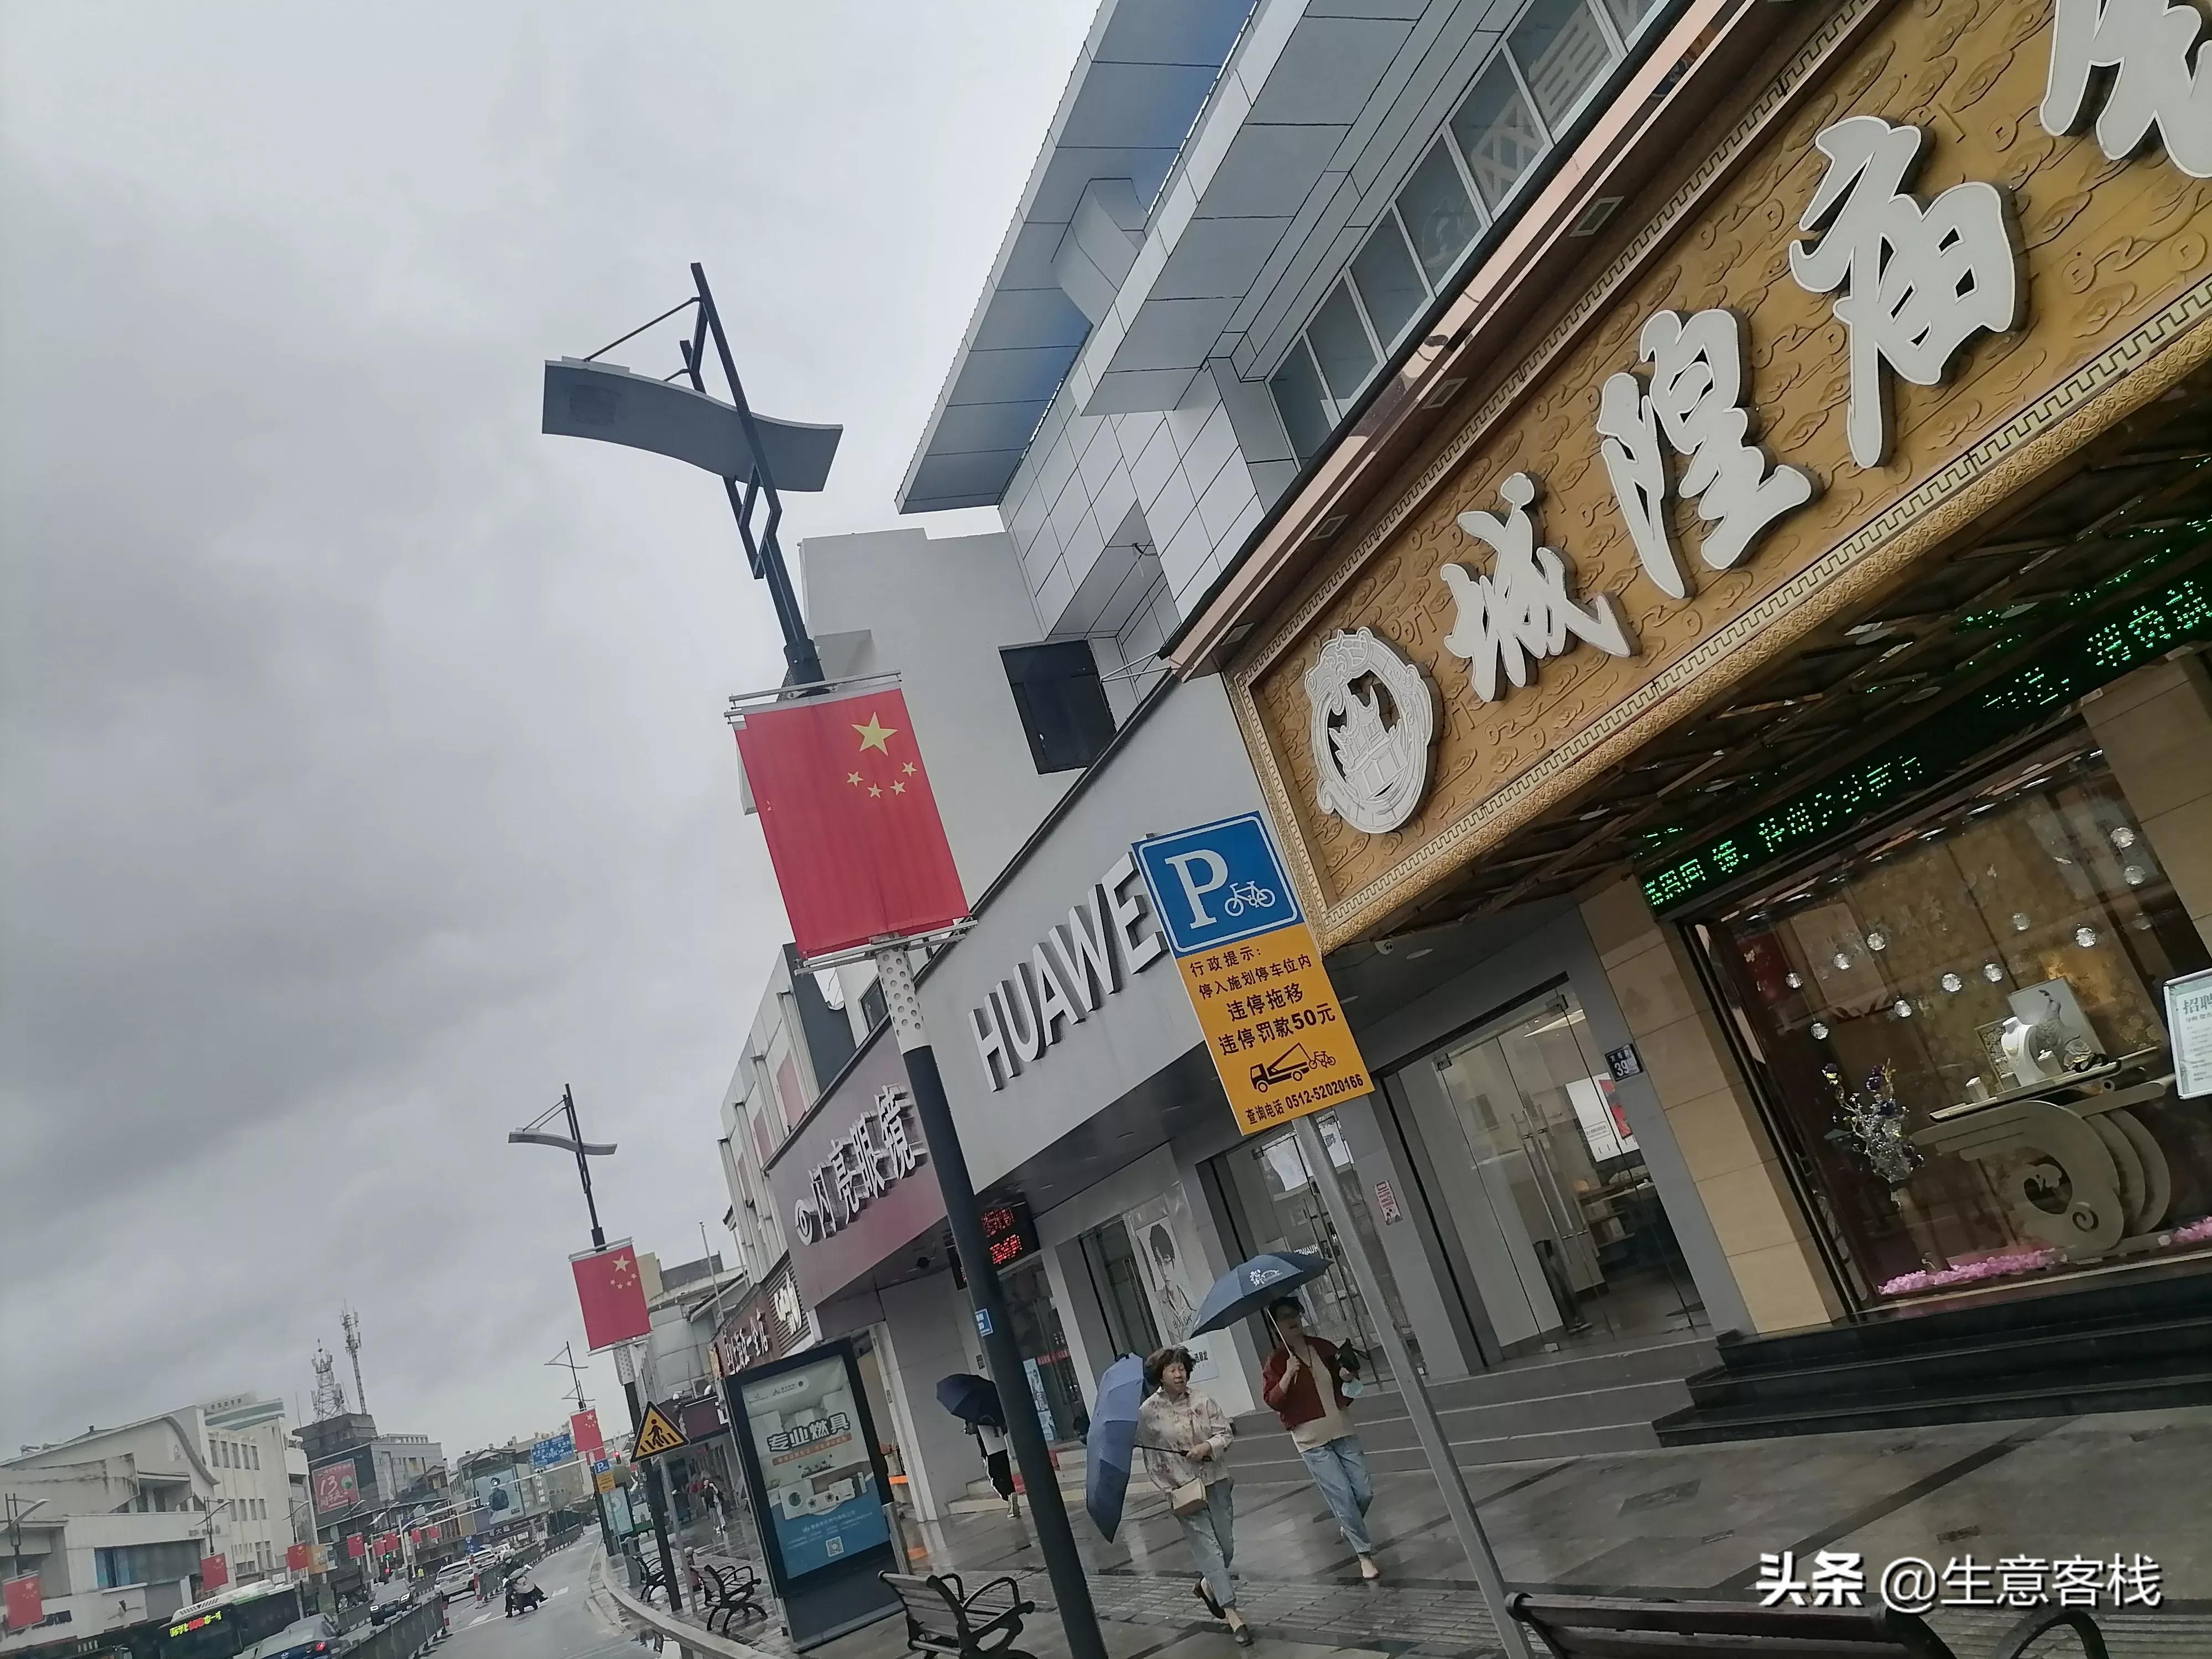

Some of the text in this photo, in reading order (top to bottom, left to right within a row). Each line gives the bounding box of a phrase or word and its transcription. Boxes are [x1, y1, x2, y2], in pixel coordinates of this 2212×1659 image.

[1165, 849, 1228, 931] P
[968, 833, 1168, 1092] HUAWE
[1198, 953, 1312, 999] 停入施划停车位内
[1218, 1001, 1337, 1056] 违停罚款50元
[1226, 982, 1304, 1023] 违停拖移
[1245, 1073, 1364, 1125] 查询电话 0512-52020166
[809, 1083, 925, 1239] 闪亮眼镜
[768, 1412, 850, 1452] 专业燃具
